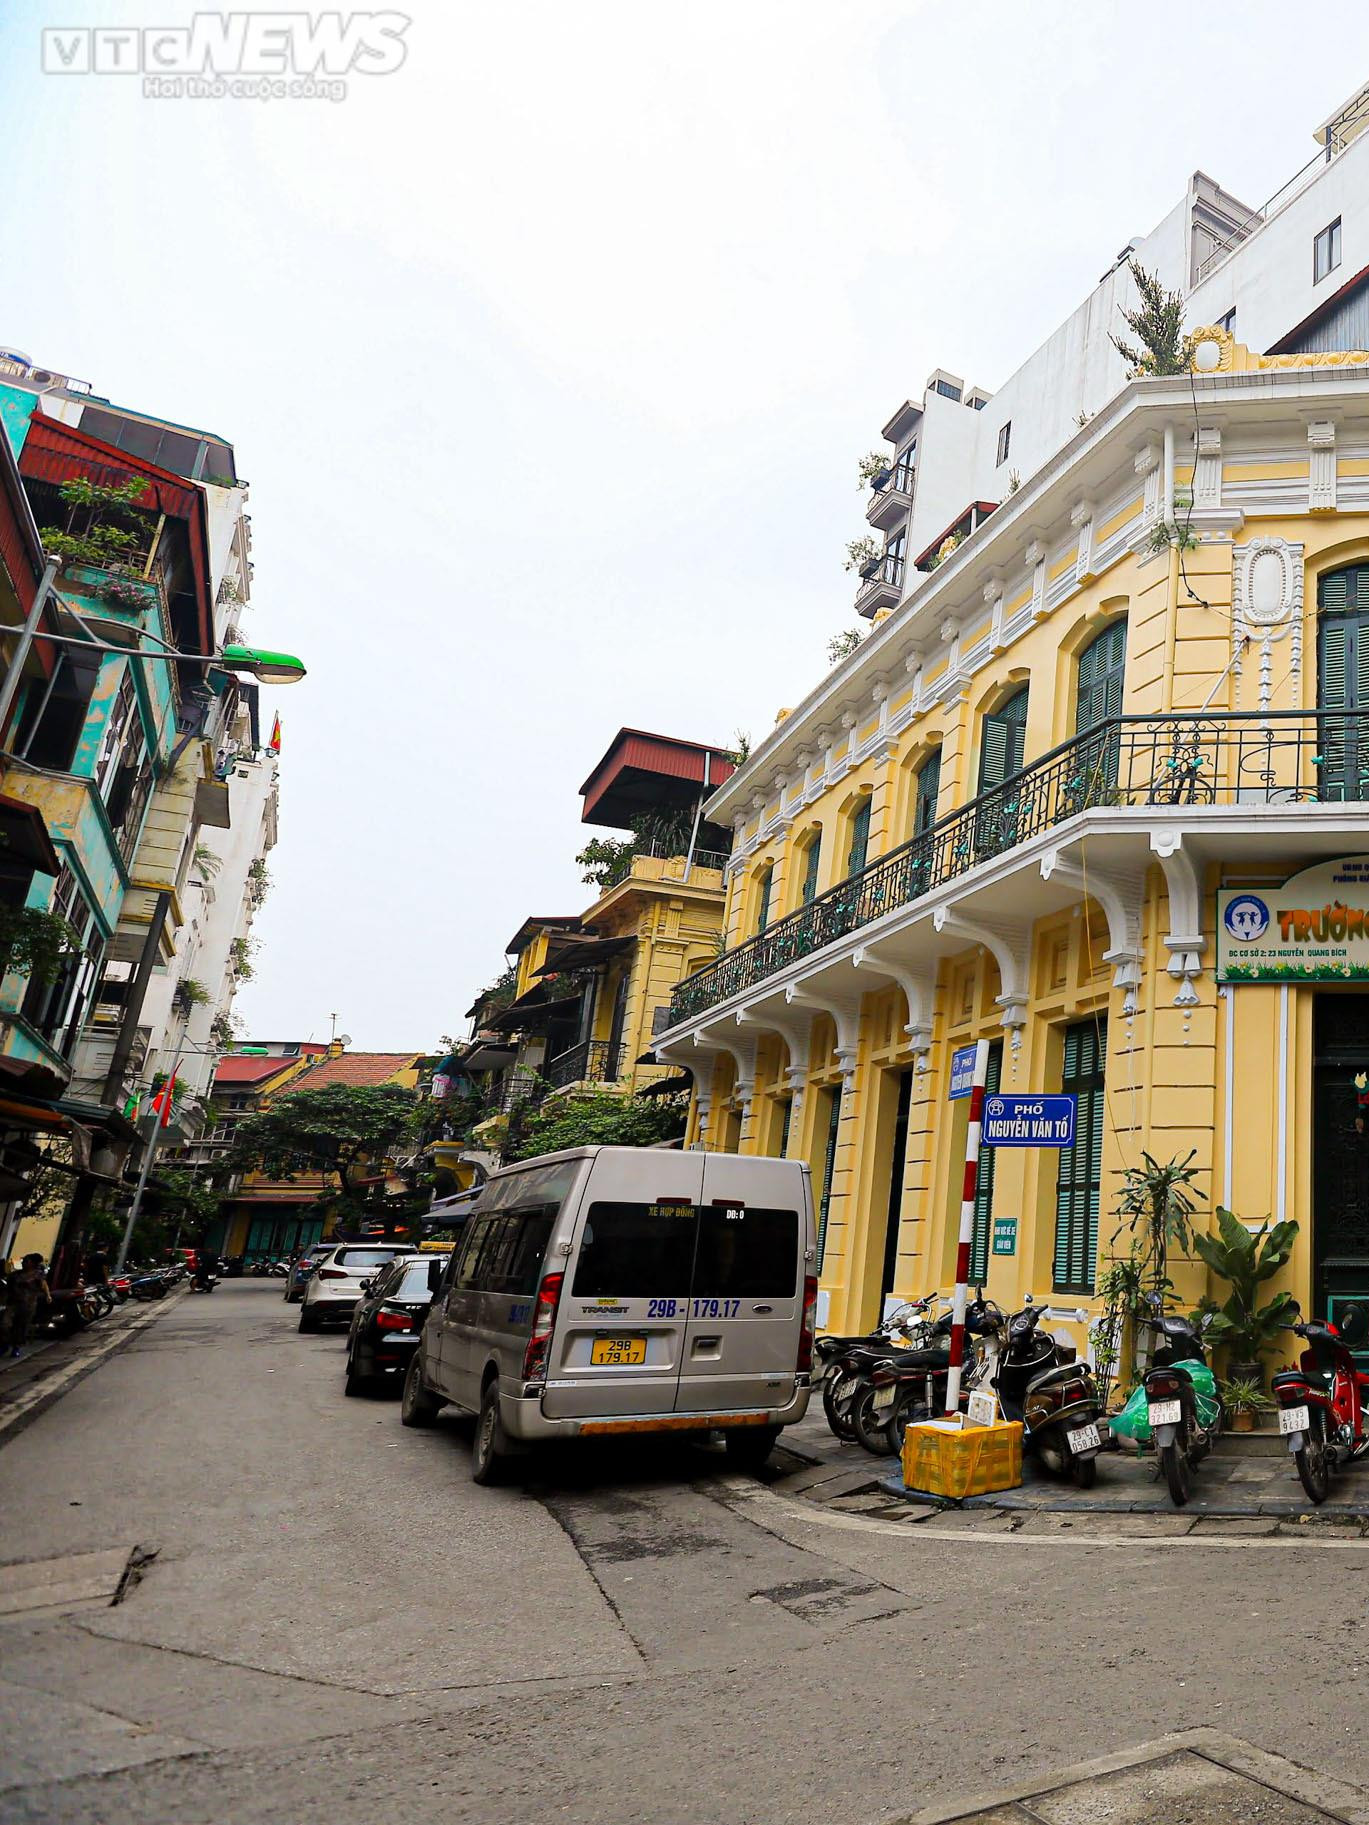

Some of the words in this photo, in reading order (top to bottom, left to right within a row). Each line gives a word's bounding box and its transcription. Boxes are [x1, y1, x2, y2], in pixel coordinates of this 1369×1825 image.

[1278, 947, 1304, 957] NGUYỄN
[1308, 949, 1330, 957] QUANG
[1331, 948, 1347, 957] BÍCH
[1014, 1101, 1044, 1115] PHỐ
[988, 1115, 1029, 1138] NGUYỄN
[1032, 1117, 1053, 1138] VĂN
[1055, 1115, 1069, 1138] TỐ
[581, 1306, 630, 1314] TRANSIT
[648, 1299, 676, 1318] 29B
[693, 1299, 740, 1317] 179.17
[608, 1340, 631, 1351] 29B
[599, 1352, 639, 1363] 179.17
